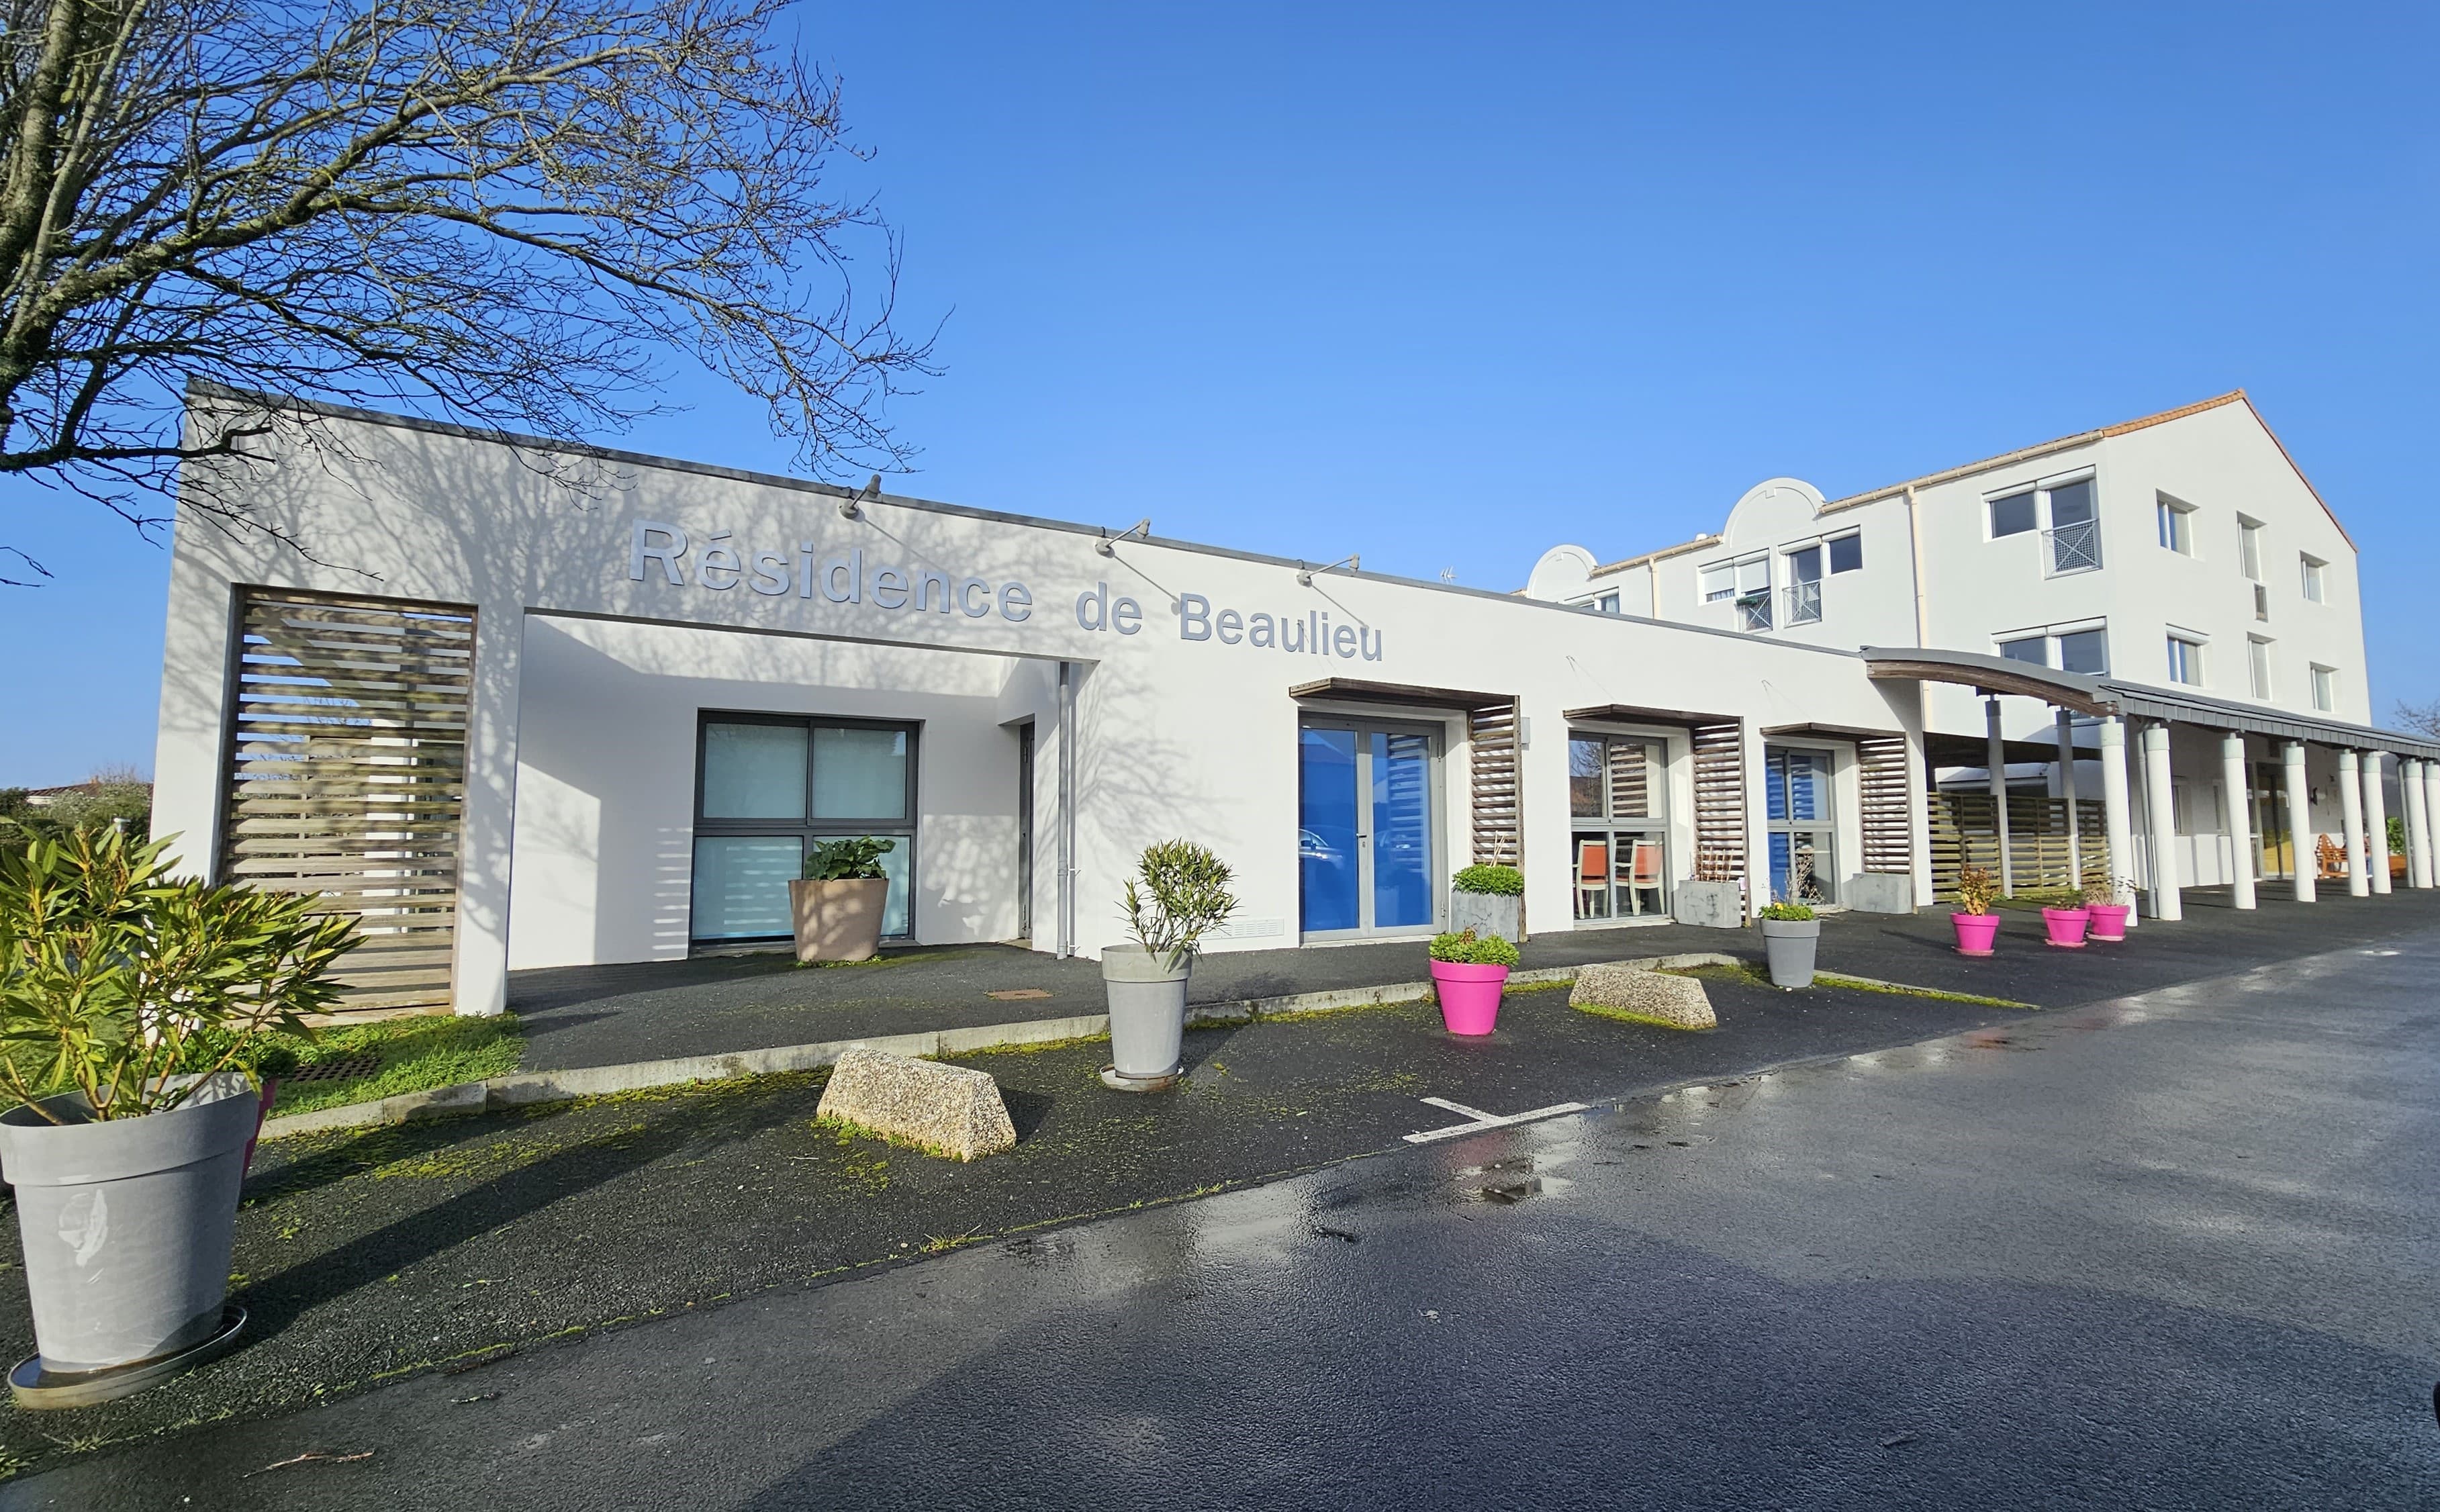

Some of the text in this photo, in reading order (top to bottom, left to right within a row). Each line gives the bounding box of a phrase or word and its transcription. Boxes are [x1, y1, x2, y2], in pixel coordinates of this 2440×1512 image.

[628, 518, 1383, 662] Résidence de Beaulieu
